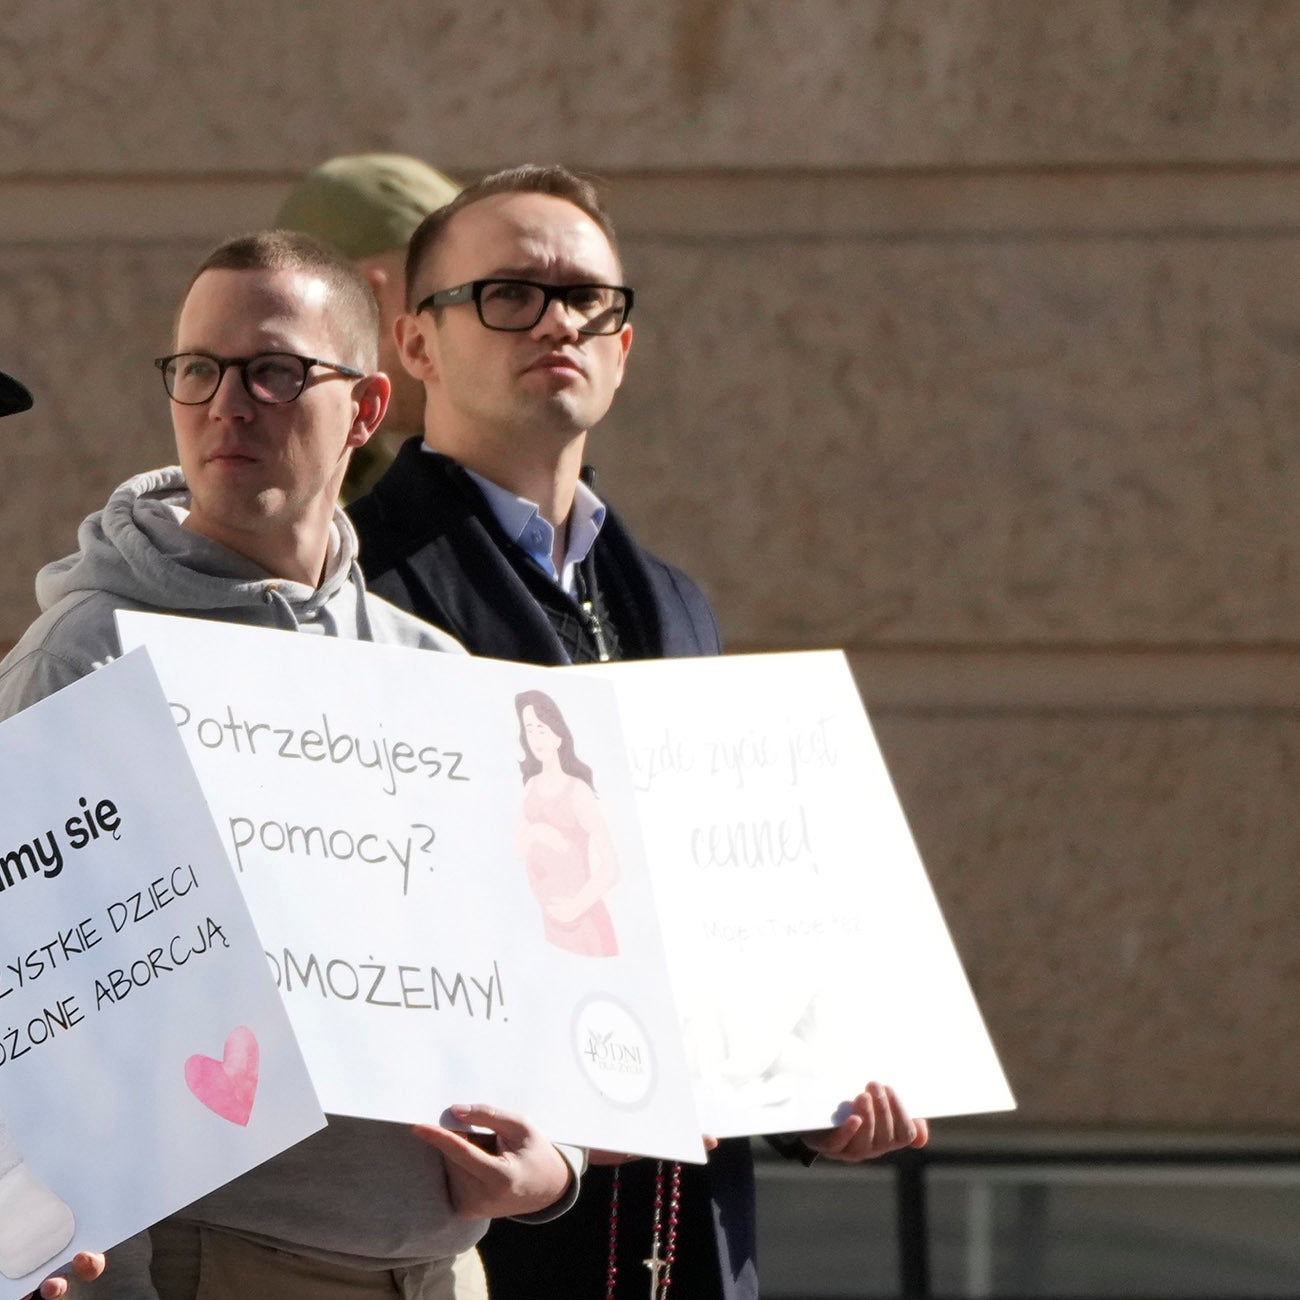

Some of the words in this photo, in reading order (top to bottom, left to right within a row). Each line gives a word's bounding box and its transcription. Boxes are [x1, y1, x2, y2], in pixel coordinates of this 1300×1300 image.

[65, 796, 122, 850] się
[228, 817, 436, 896] pomocy?
[690, 804, 819, 876] cenne!
[106, 864, 199, 933] DZIECI
[93, 916, 229, 1011] ABORCJĄ
[264, 947, 509, 1023] MOŻEMY!
[610, 1043, 642, 1065] DNI
